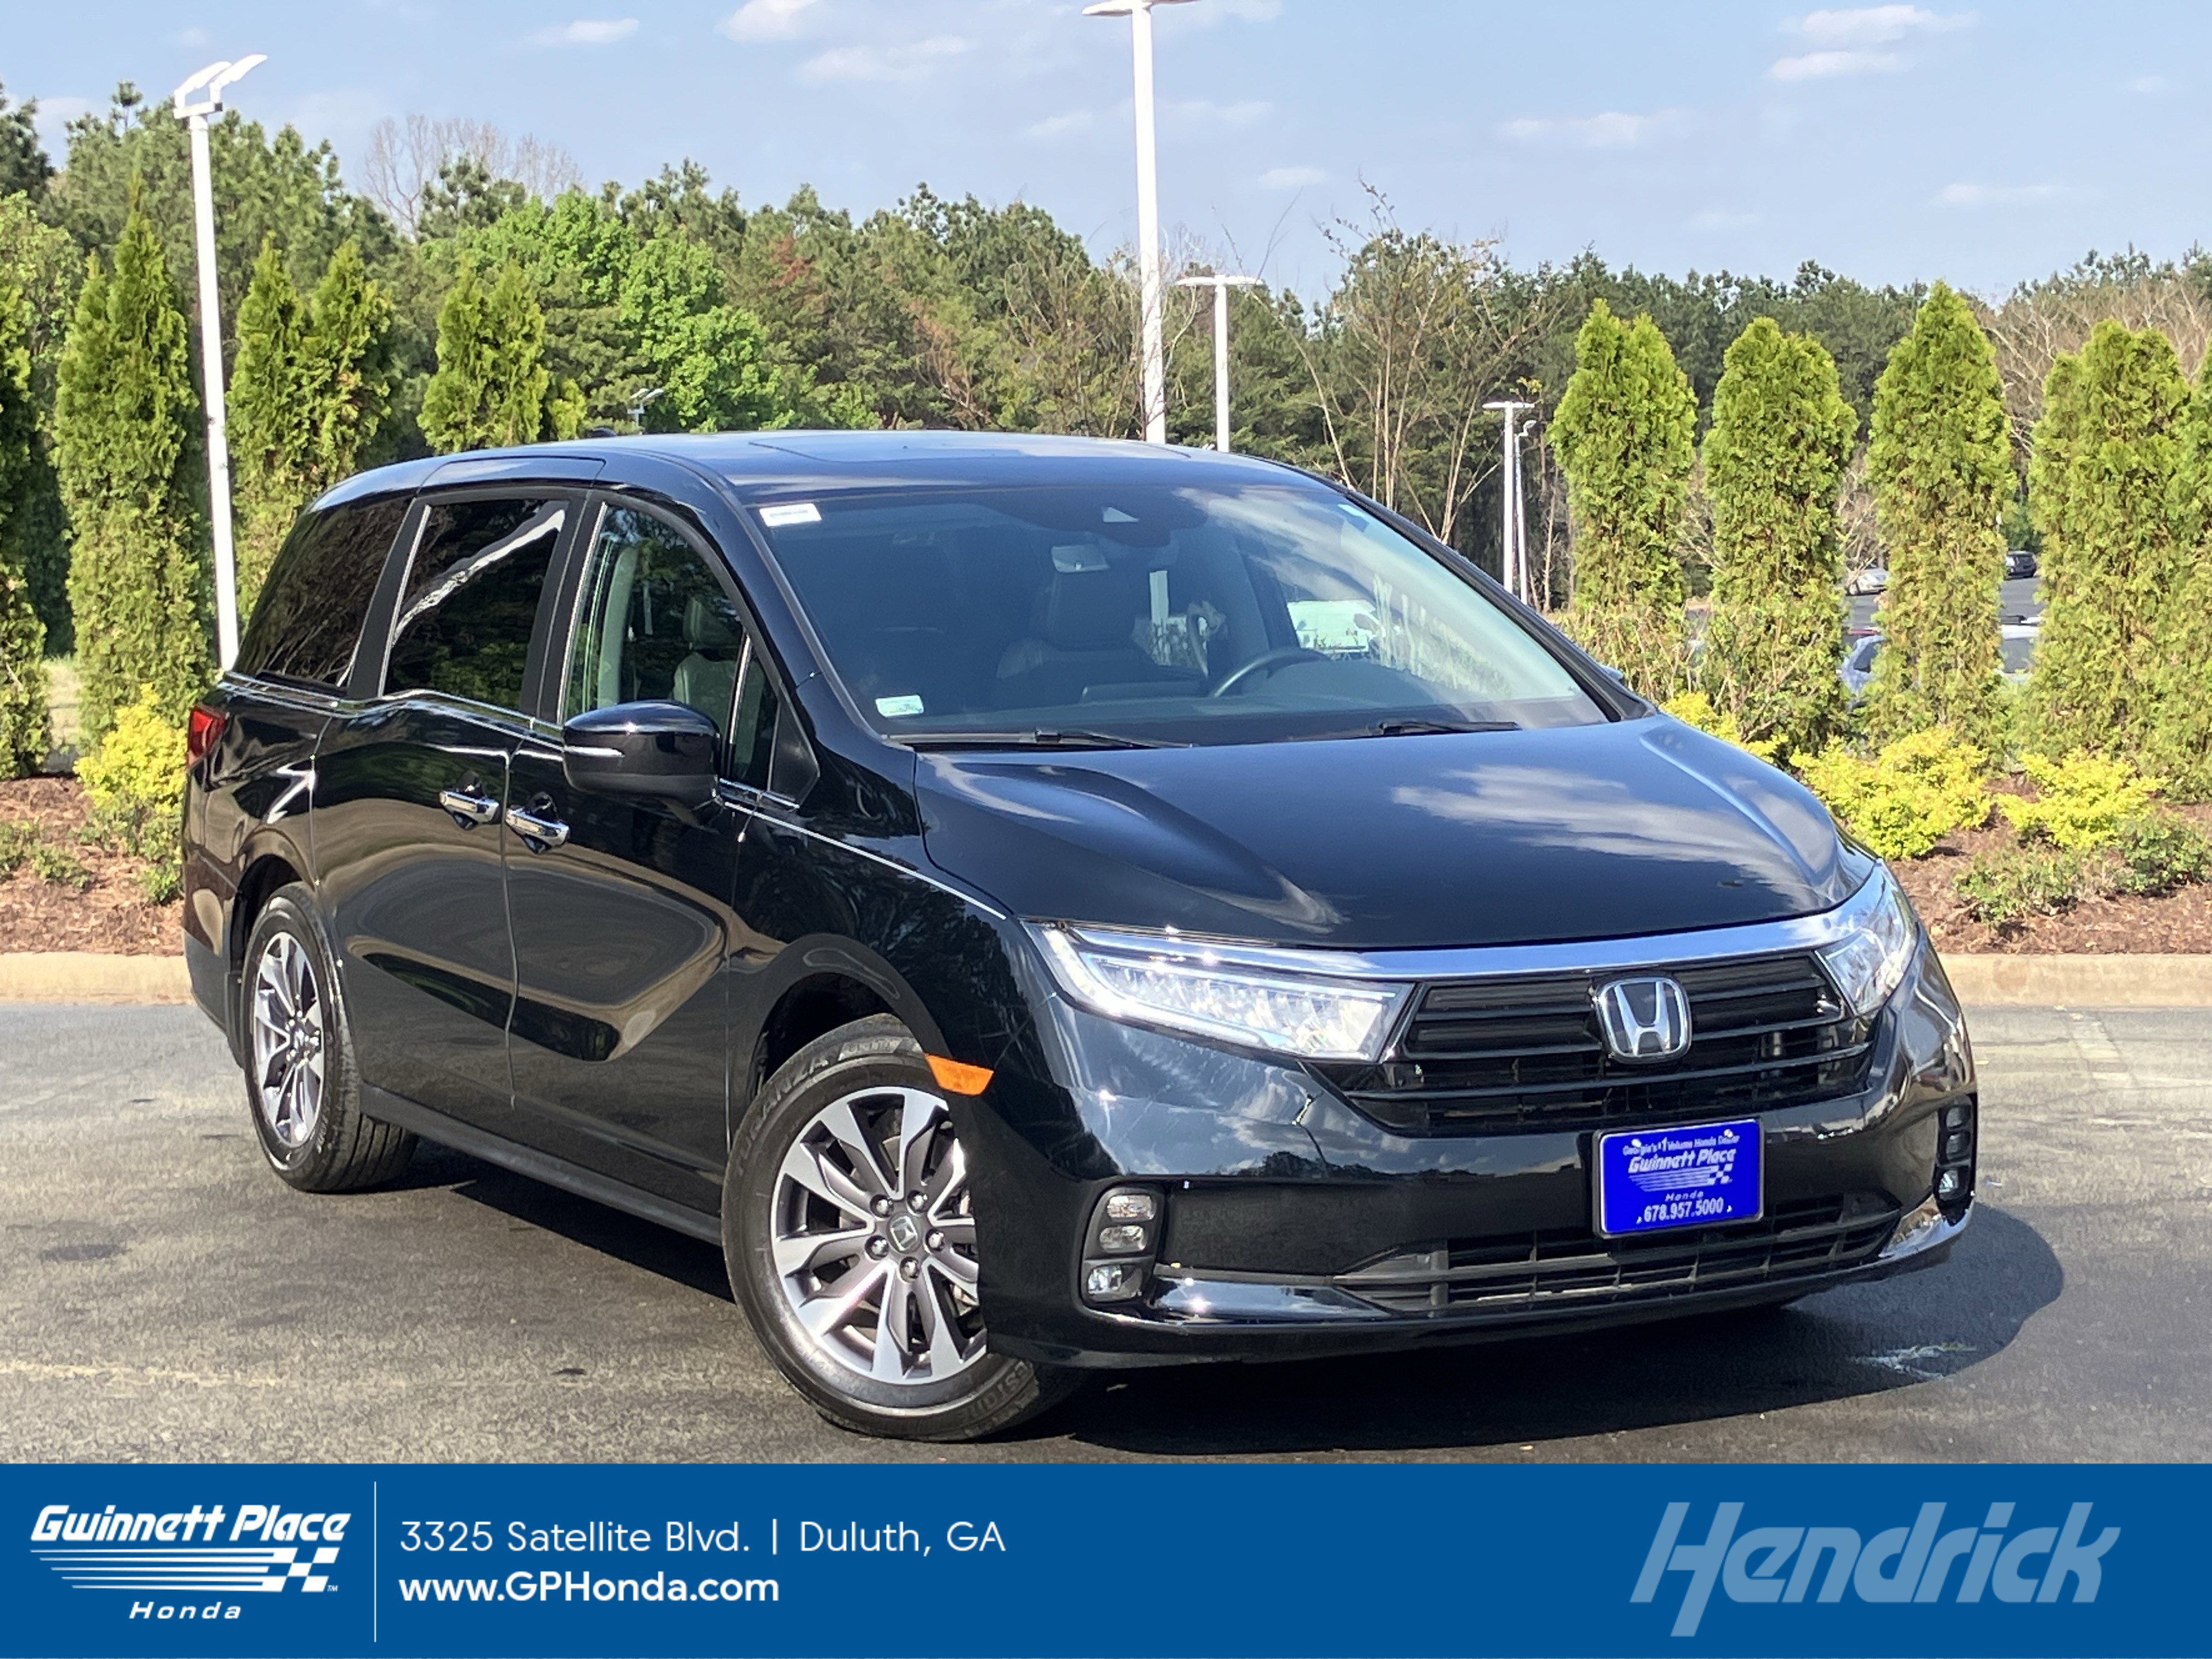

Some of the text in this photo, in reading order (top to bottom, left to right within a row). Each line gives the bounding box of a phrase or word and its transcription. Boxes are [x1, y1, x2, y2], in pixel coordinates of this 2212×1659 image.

[1668, 1141, 1693, 1151] Volume
[1694, 1136, 1717, 1148] Honda
[1718, 1135, 1740, 1146] Dealer
[1628, 1148, 1737, 1173] Gwinnett Place
[1664, 1190, 1704, 1202] Honda
[1644, 1197, 1724, 1222] 678.957.5000
